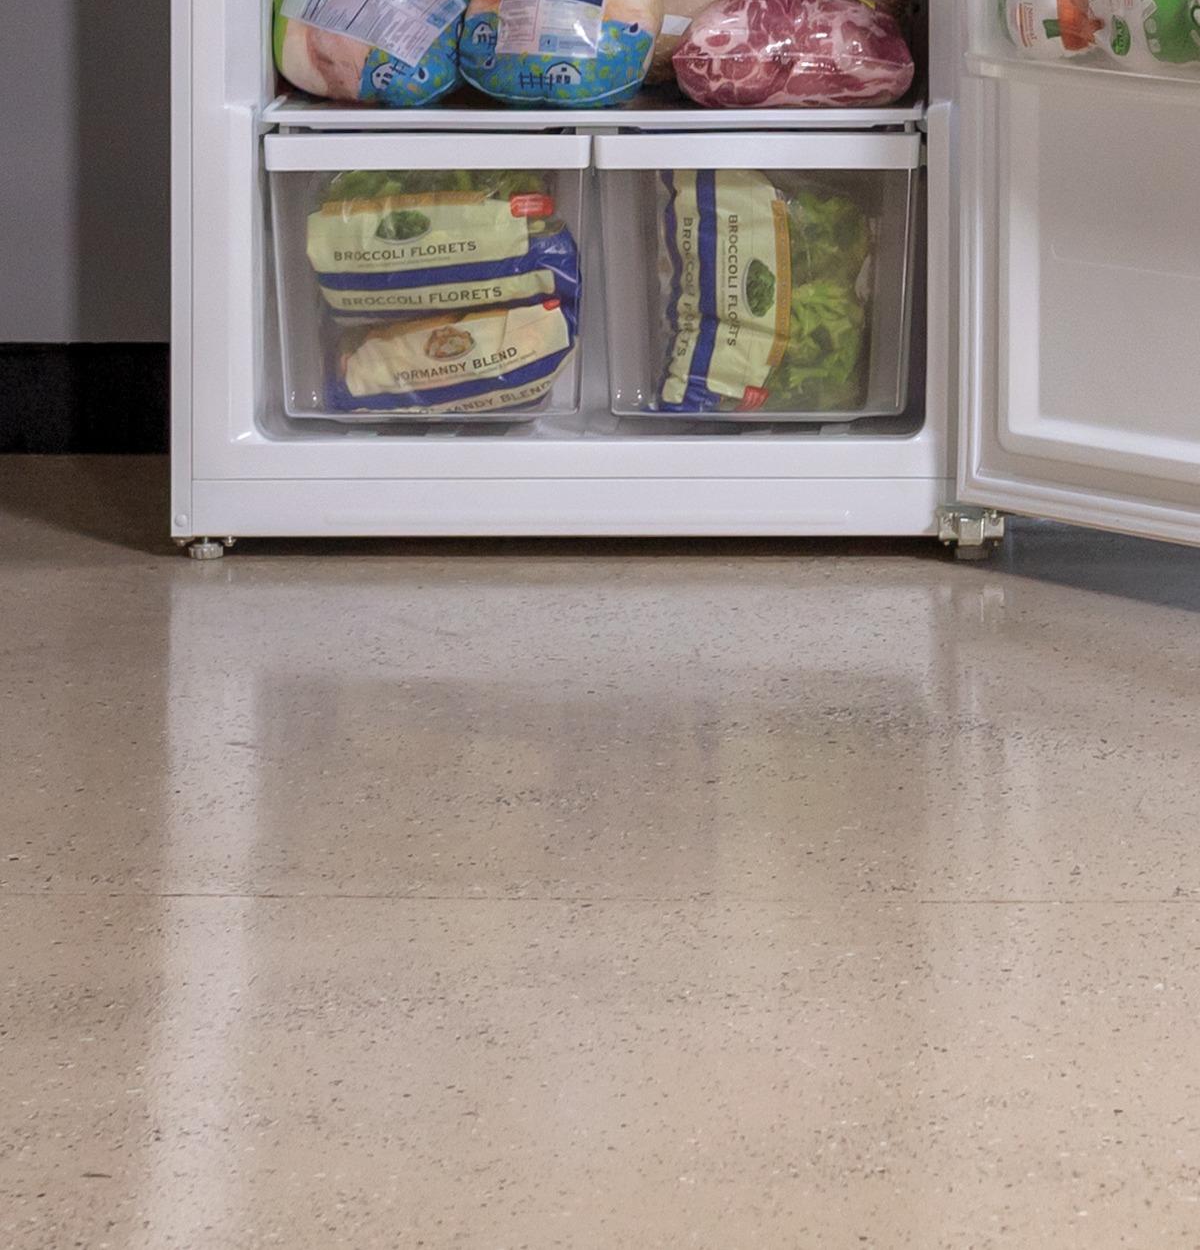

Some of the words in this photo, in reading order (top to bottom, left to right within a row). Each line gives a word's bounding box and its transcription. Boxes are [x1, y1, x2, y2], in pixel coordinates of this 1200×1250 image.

[334, 249, 405, 262] BROCCOLI
[410, 241, 477, 257] FLORETS
[728, 214, 738, 289] BROCCOLI
[342, 294, 423, 307] BROCCOLI
[429, 286, 502, 304] FLORETS
[473, 347, 518, 369] BLEND
